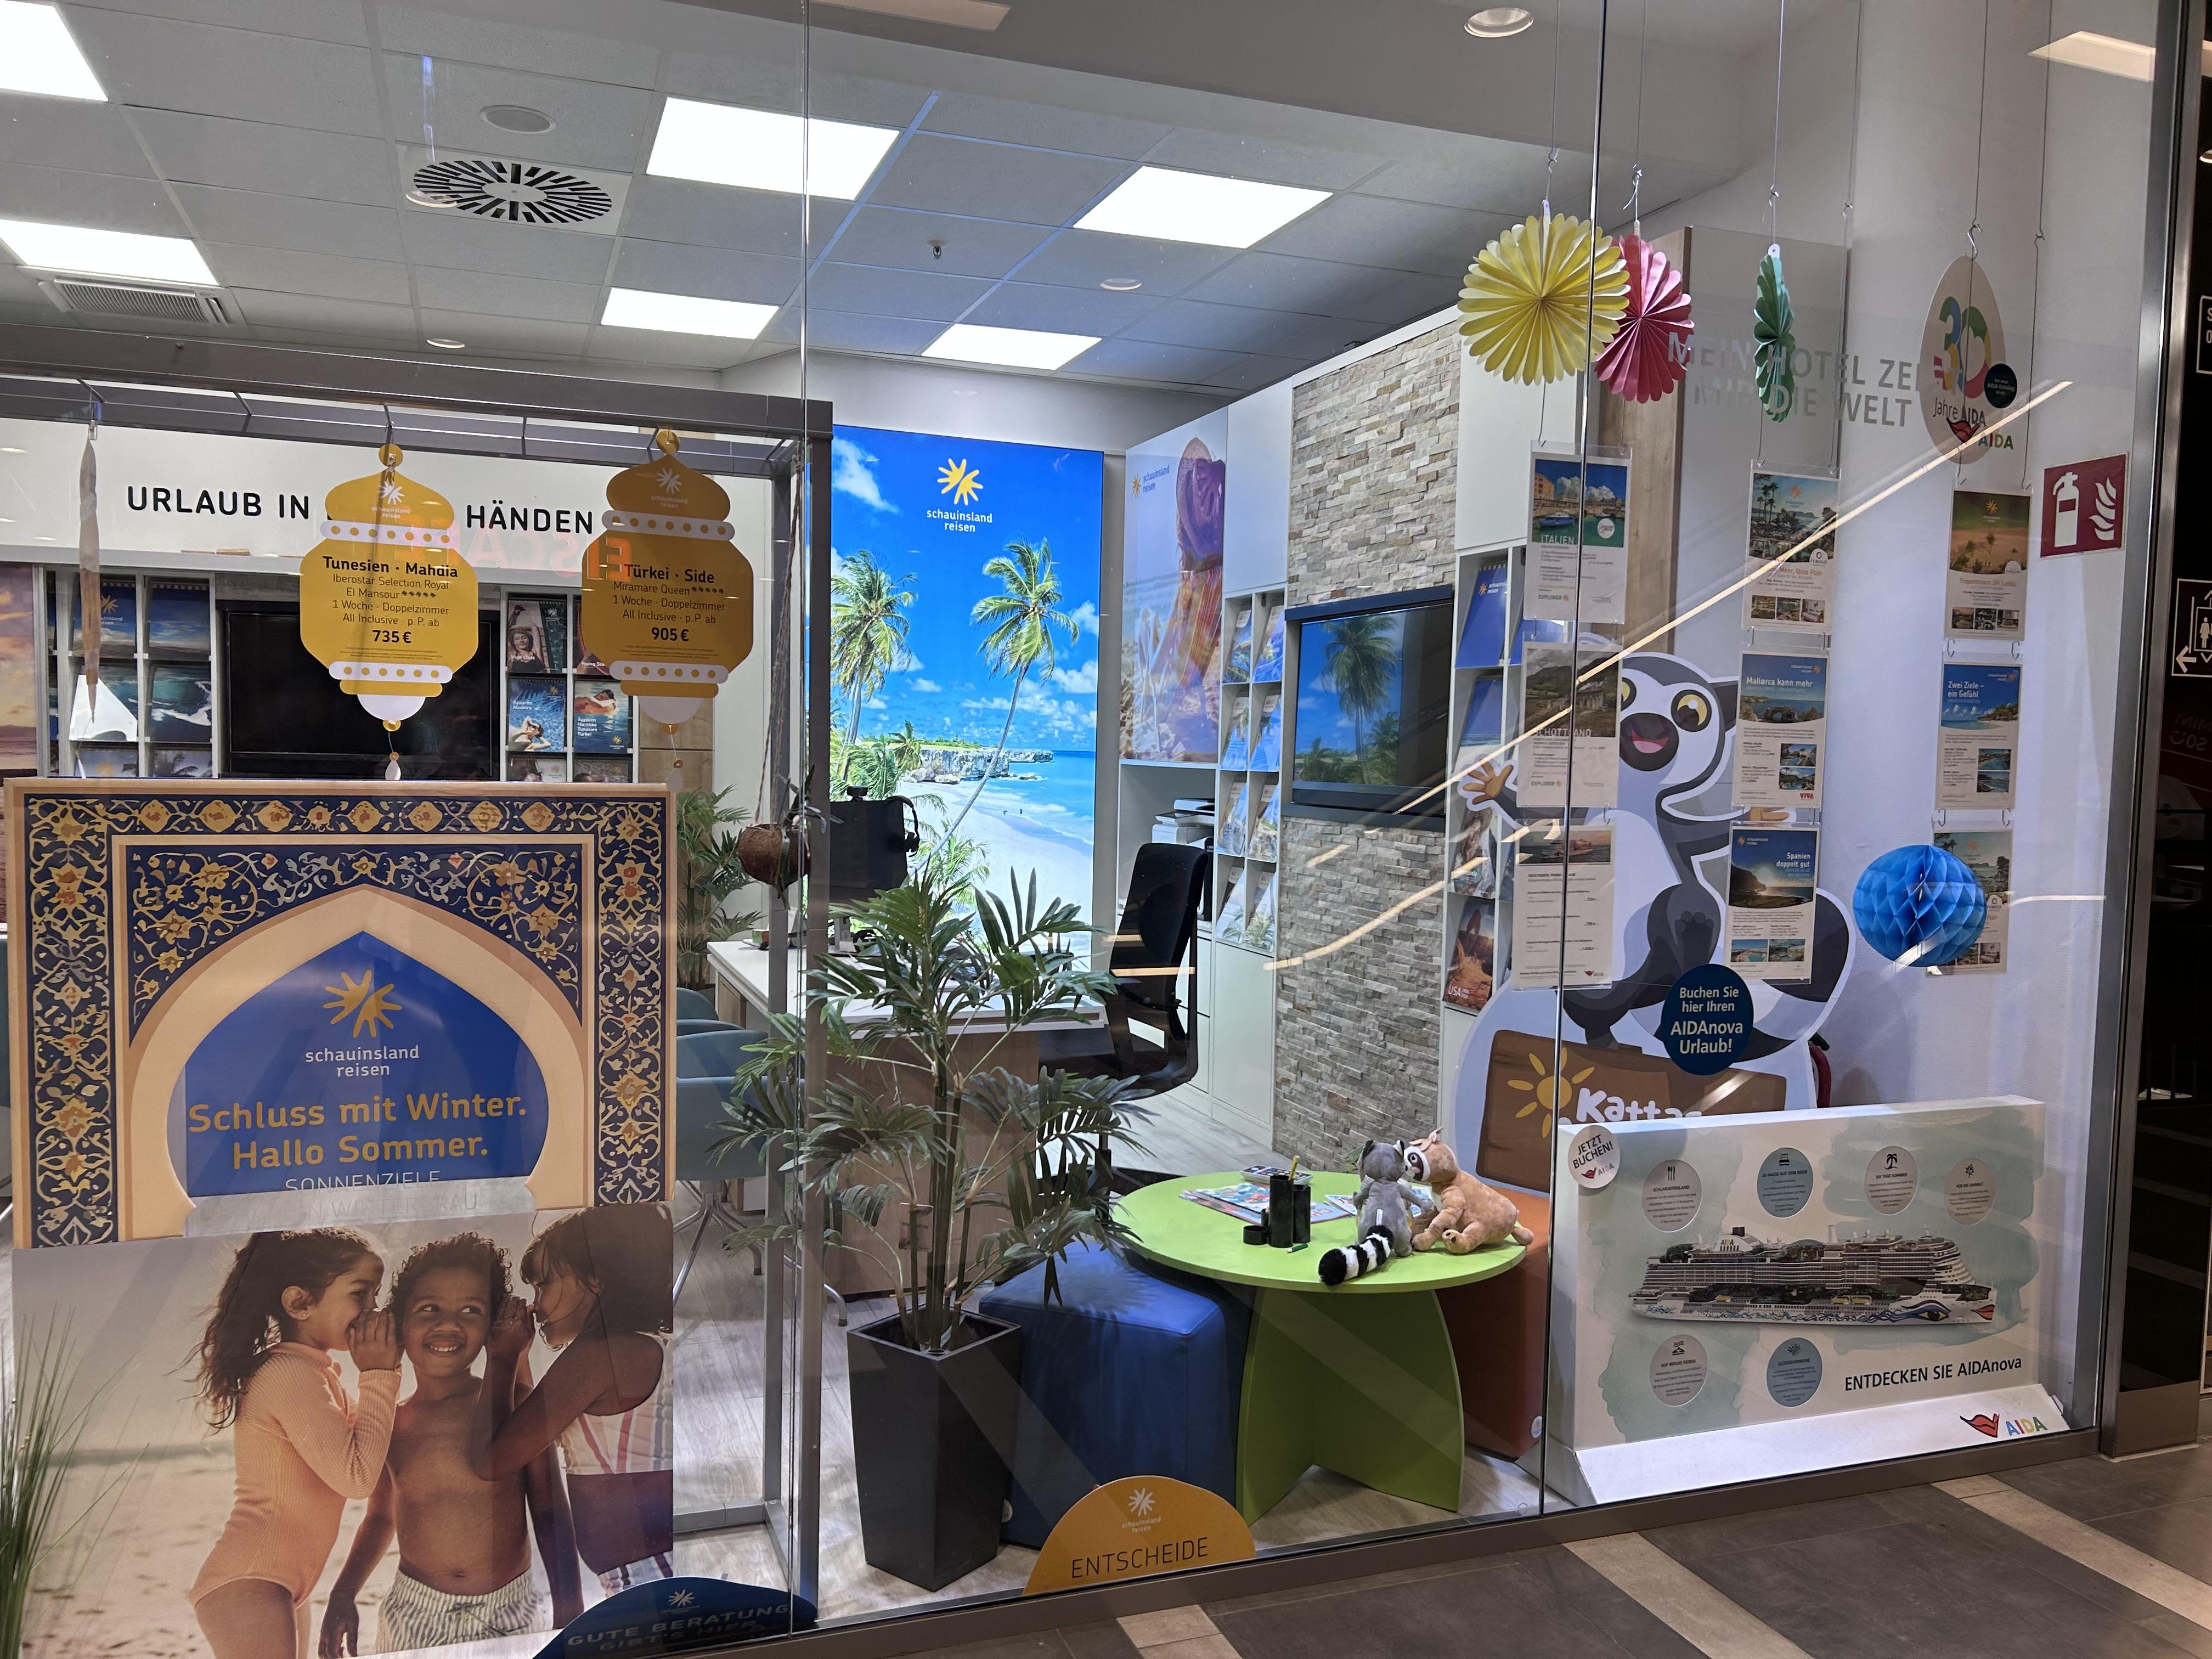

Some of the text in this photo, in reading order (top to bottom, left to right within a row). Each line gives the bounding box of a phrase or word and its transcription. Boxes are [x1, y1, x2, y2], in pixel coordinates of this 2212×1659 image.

[1668, 332, 1751, 371] MEIN
[1767, 345, 1866, 385] HOTEL
[1770, 383, 1818, 417] DIE
[1831, 390, 1912, 427] WELT
[1933, 397, 1986, 427] Jahre AIDA
[1977, 431, 2014, 450] AIDA
[1143, 464, 1170, 483] schauinsland
[1143, 483, 1156, 493] reisen
[127, 485, 592, 534] URLAUB IN HÄNDEN
[926, 508, 992, 523] schauinsland
[944, 521, 975, 532] reisen
[1541, 534, 1575, 545] ITALIEN
[323, 556, 458, 578] Tunesien Mahdia
[624, 563, 714, 583] Türkei Side
[332, 574, 449, 590] Iberostar Selection Royal
[613, 581, 690, 595] Miramare Queen
[346, 588, 400, 599] El Mansour
[332, 599, 450, 614] 1 Woche Doppelzimmer
[612, 595, 726, 611] 1 Woche Doppelzimmer
[342, 613, 356, 622] All
[358, 614, 398, 624] Inclusive
[428, 618, 439, 627] ab
[623, 610, 635, 618] All
[638, 610, 676, 622] Inclusive
[705, 614, 716, 624] ab
[1746, 676, 1775, 685] Mallorca
[1778, 678, 1793, 686] kann
[1948, 681, 1963, 689] Zwei
[1963, 681, 1979, 689] Ziele
[1959, 690, 1979, 698] Gefühl
[1535, 728, 1592, 737] SCHOTTAND
[1786, 852, 1810, 860] Spanien
[1776, 860, 1799, 868] doppelt
[1448, 984, 1461, 997] USA
[1679, 986, 1739, 998] Buchen Sie
[1682, 1001, 1735, 1012] hier Ihren
[1670, 1020, 1743, 1036] AIDAnova
[305, 1044, 420, 1062] schauinsland
[1679, 1038, 1733, 1054] Urlaub!
[336, 1063, 390, 1077] reisen
[189, 1092, 527, 1132] Schluss mit Winter.
[1577, 1133, 1601, 1155] JETZT
[233, 1135, 488, 1171] Hallo Sommer.
[1572, 1141, 1613, 1169] BUCHEN!
[1598, 1163, 1615, 1175] AIDA
[1844, 1357, 2022, 1391] ENTDECKEN SIE AIDAnova
[2005, 1417, 2047, 1436] AIDA
[1122, 1515, 1161, 1529] schauinsland
[1132, 1524, 1151, 1533] reisen
[1071, 1536, 1209, 1578] ENTSCHEIDE
[567, 1626, 640, 1646] GUTE
[651, 1603, 789, 1633] BERATUNG
